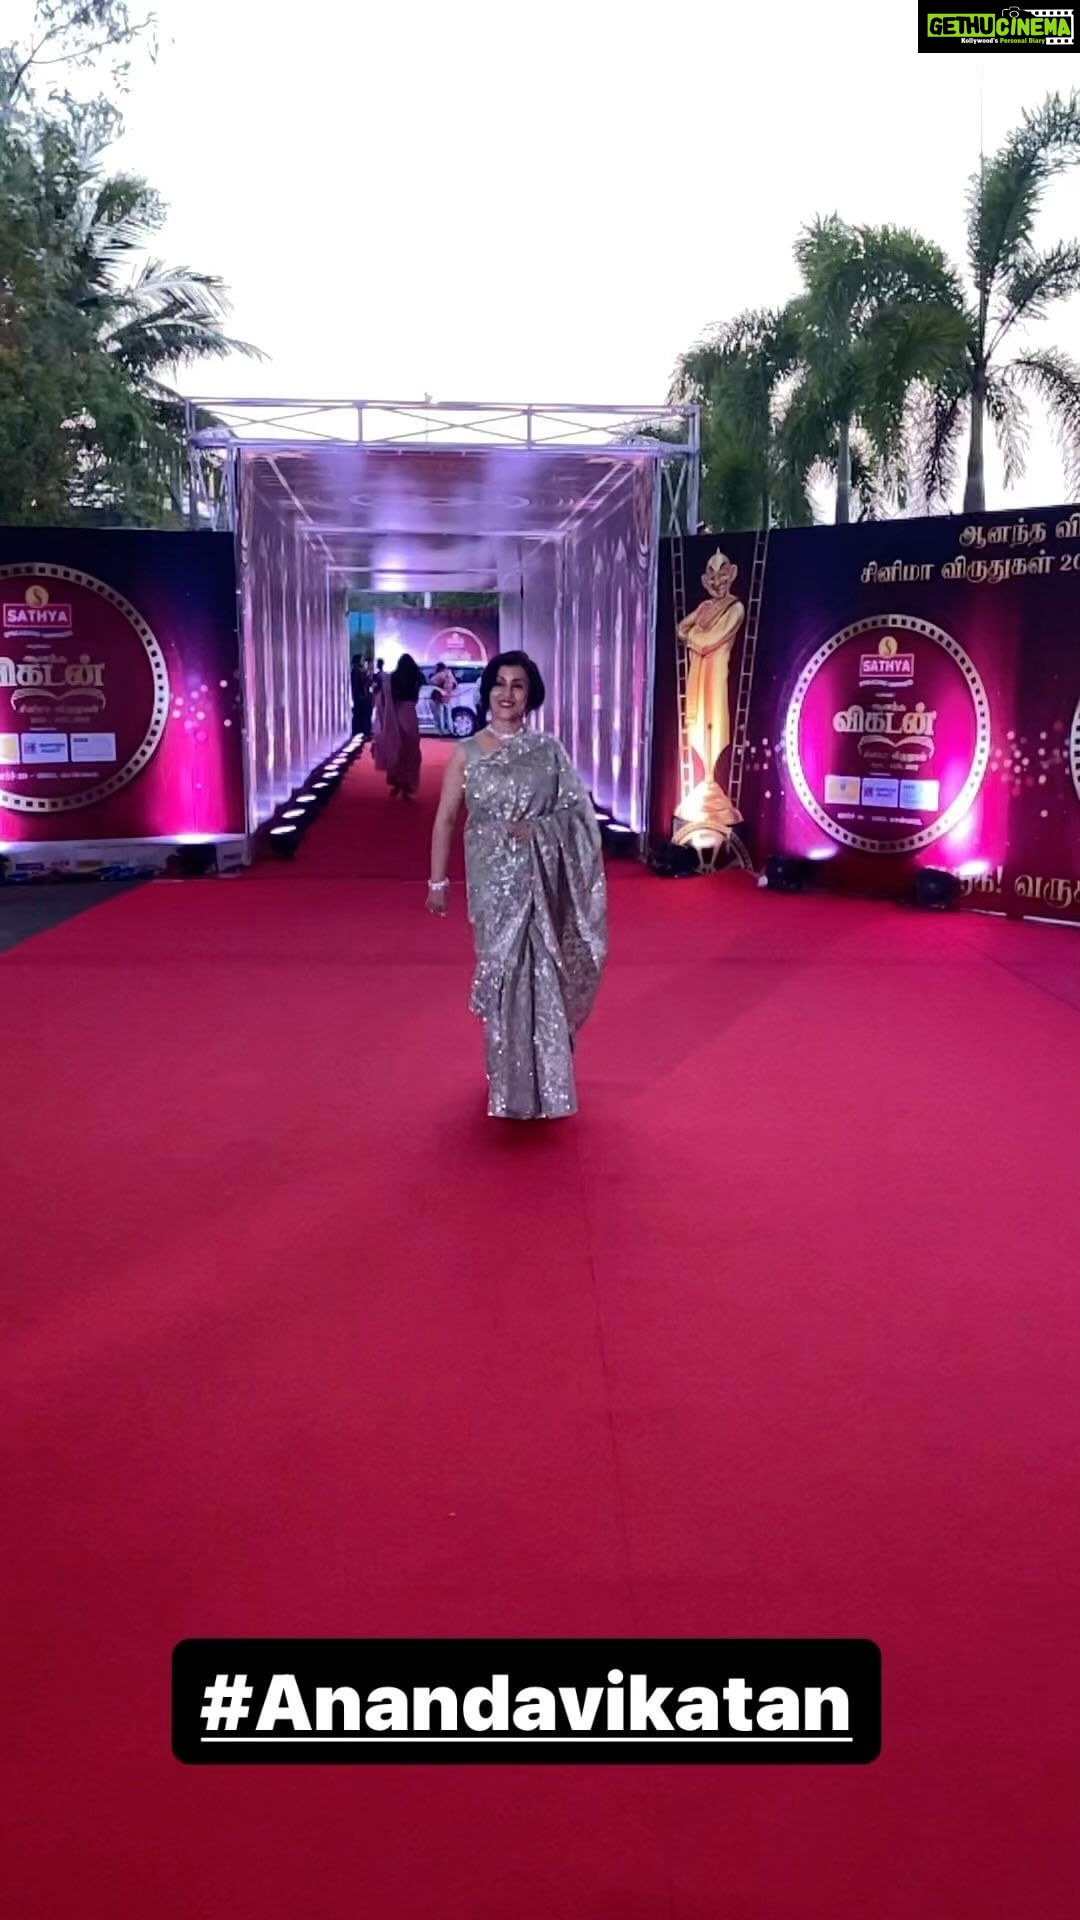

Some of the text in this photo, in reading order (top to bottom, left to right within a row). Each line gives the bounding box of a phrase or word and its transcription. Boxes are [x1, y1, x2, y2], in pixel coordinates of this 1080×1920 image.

[959, 517, 1047, 548] ஆனந்த
[860, 560, 934, 583] சினிமா
[941, 549, 1055, 583] விருதுகள்
[7, 609, 68, 623] SATHYA
[863, 659, 911, 673] SATHYA
[833, 702, 937, 736] விகடன்
